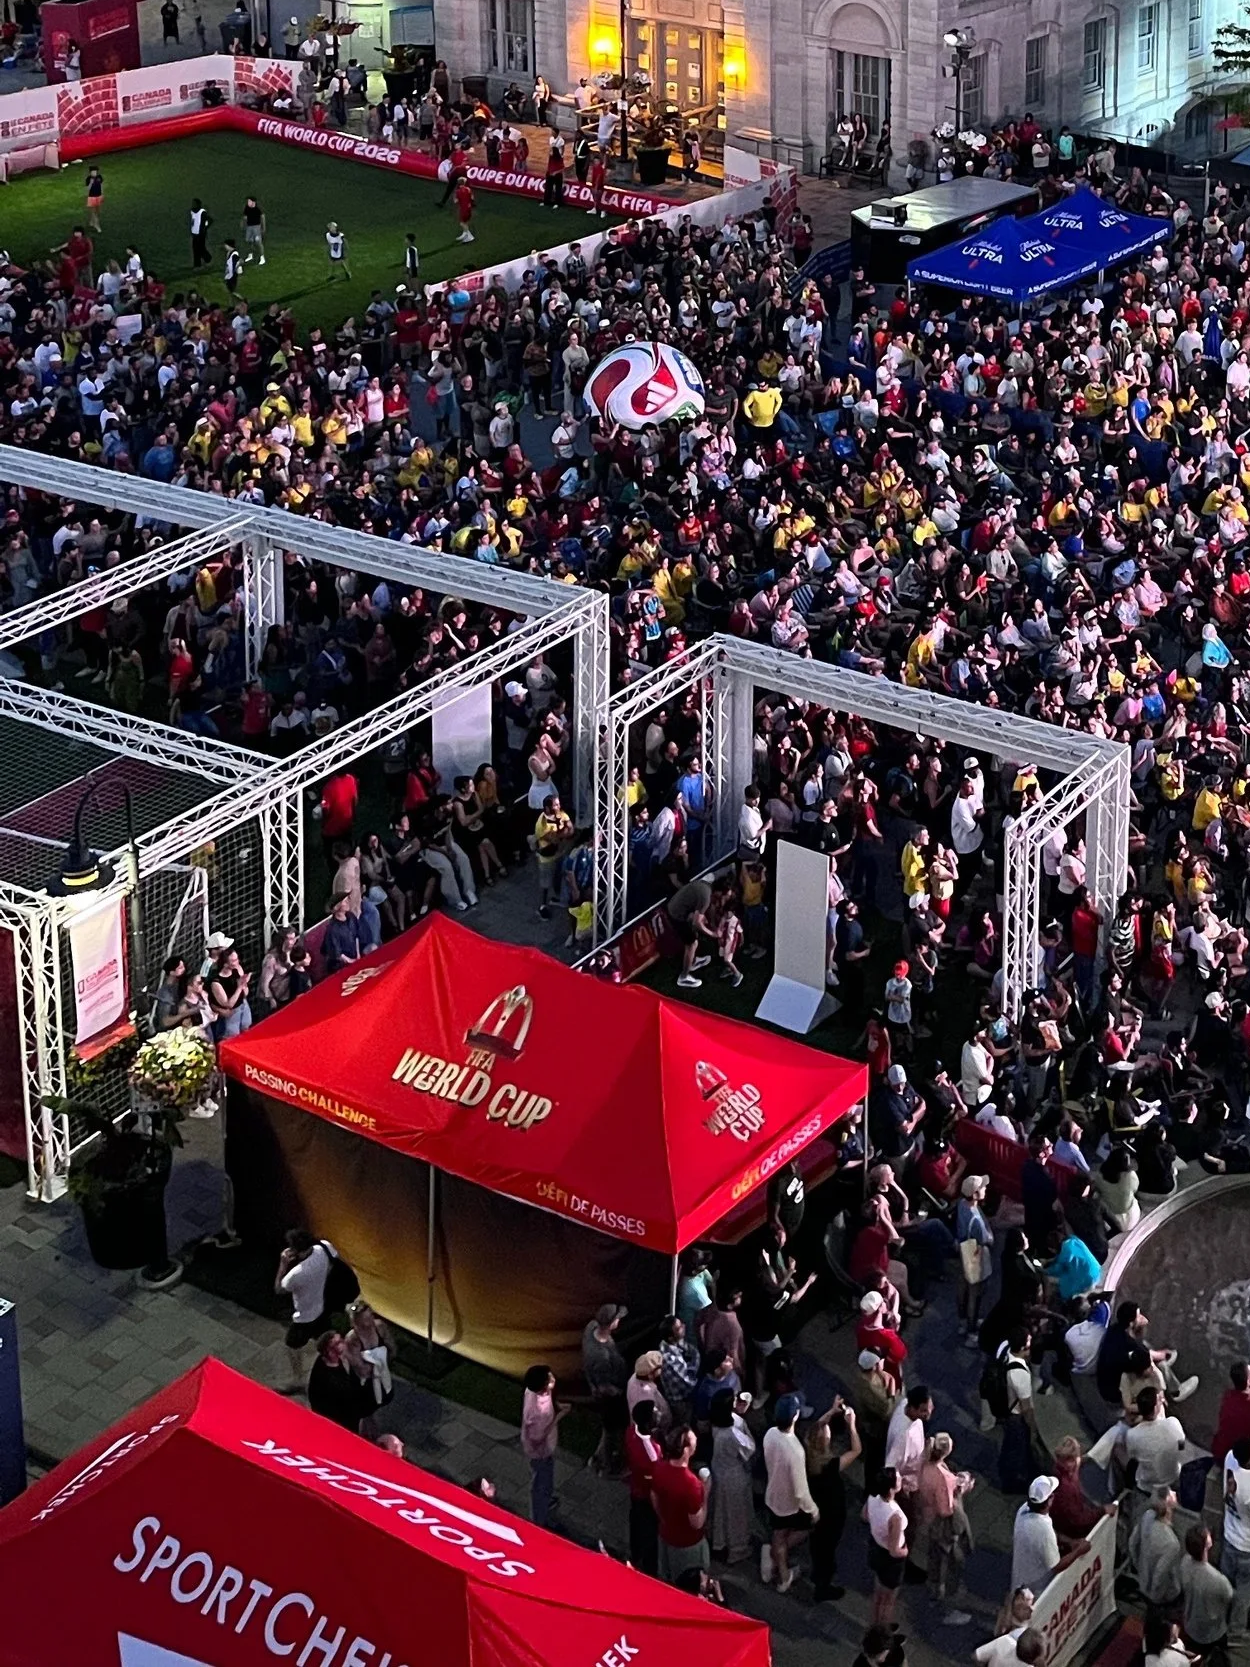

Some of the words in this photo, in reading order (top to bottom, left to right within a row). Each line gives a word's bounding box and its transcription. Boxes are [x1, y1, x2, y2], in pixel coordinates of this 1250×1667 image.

[132, 88, 171, 101] CANADA
[257, 118, 282, 135] FIFA
[284, 123, 327, 147] WORLD
[328, 135, 354, 152] CUP
[354, 142, 401, 164] 2026
[466, 166, 506, 184] OUPE
[505, 173, 527, 188] DU
[601, 190, 619, 208] LA
[621, 195, 653, 214] FIFA
[1043, 217, 1084, 231] ULTRA
[1099, 213, 1129, 229] ULTRA
[961, 246, 1004, 265] ULTRA
[1020, 243, 1056, 263] ULTRA
[465, 1047, 497, 1072] FIFA
[245, 1064, 297, 1096] PASSING
[298, 1087, 377, 1131] CHALLENGE
[391, 1047, 492, 1107] WORLD
[486, 1084, 553, 1130] CUP
[730, 1105, 765, 1142] CUP
[570, 1194, 590, 1215] DE
[590, 1204, 646, 1236] PASSES
[30, 1414, 180, 1522] SPORTCHEK
[240, 1439, 536, 1578] SPORTCHEK
